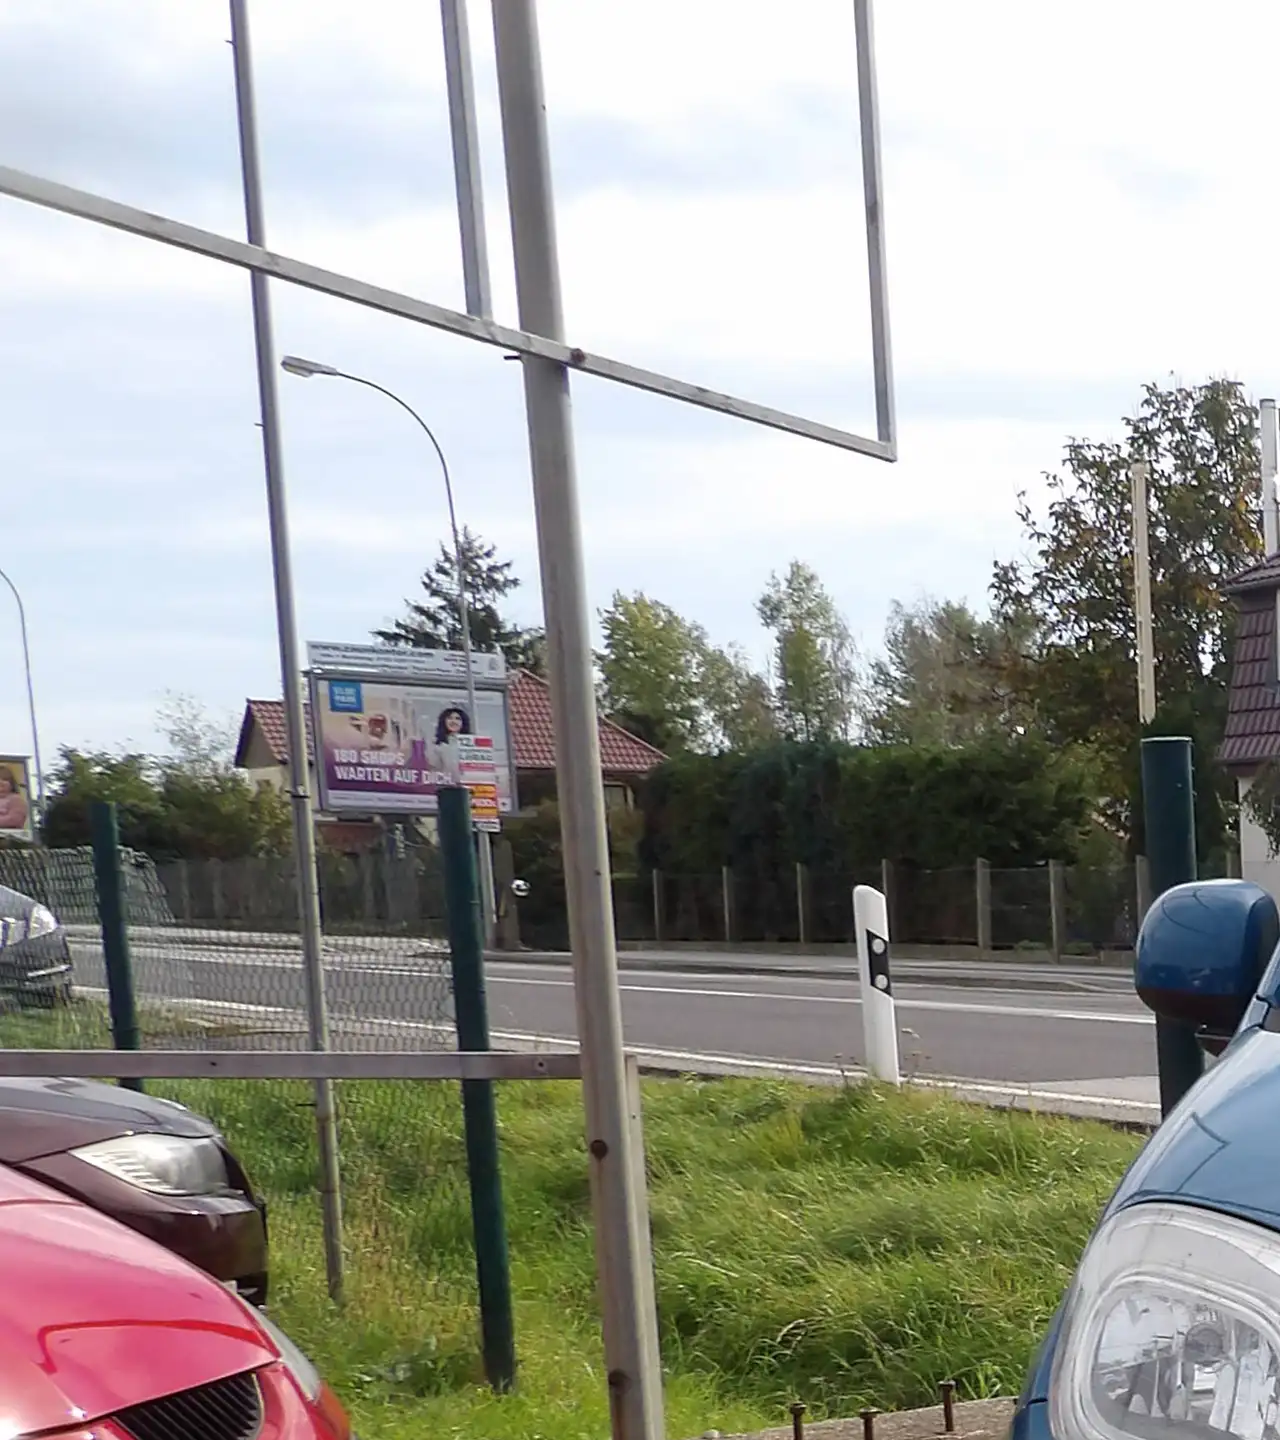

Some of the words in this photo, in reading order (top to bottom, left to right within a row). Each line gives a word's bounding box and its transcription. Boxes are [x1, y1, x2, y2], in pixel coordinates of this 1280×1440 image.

[360, 751, 405, 766] SHOPS
[334, 765, 390, 782] WARTEN
[394, 769, 419, 784] AUF
